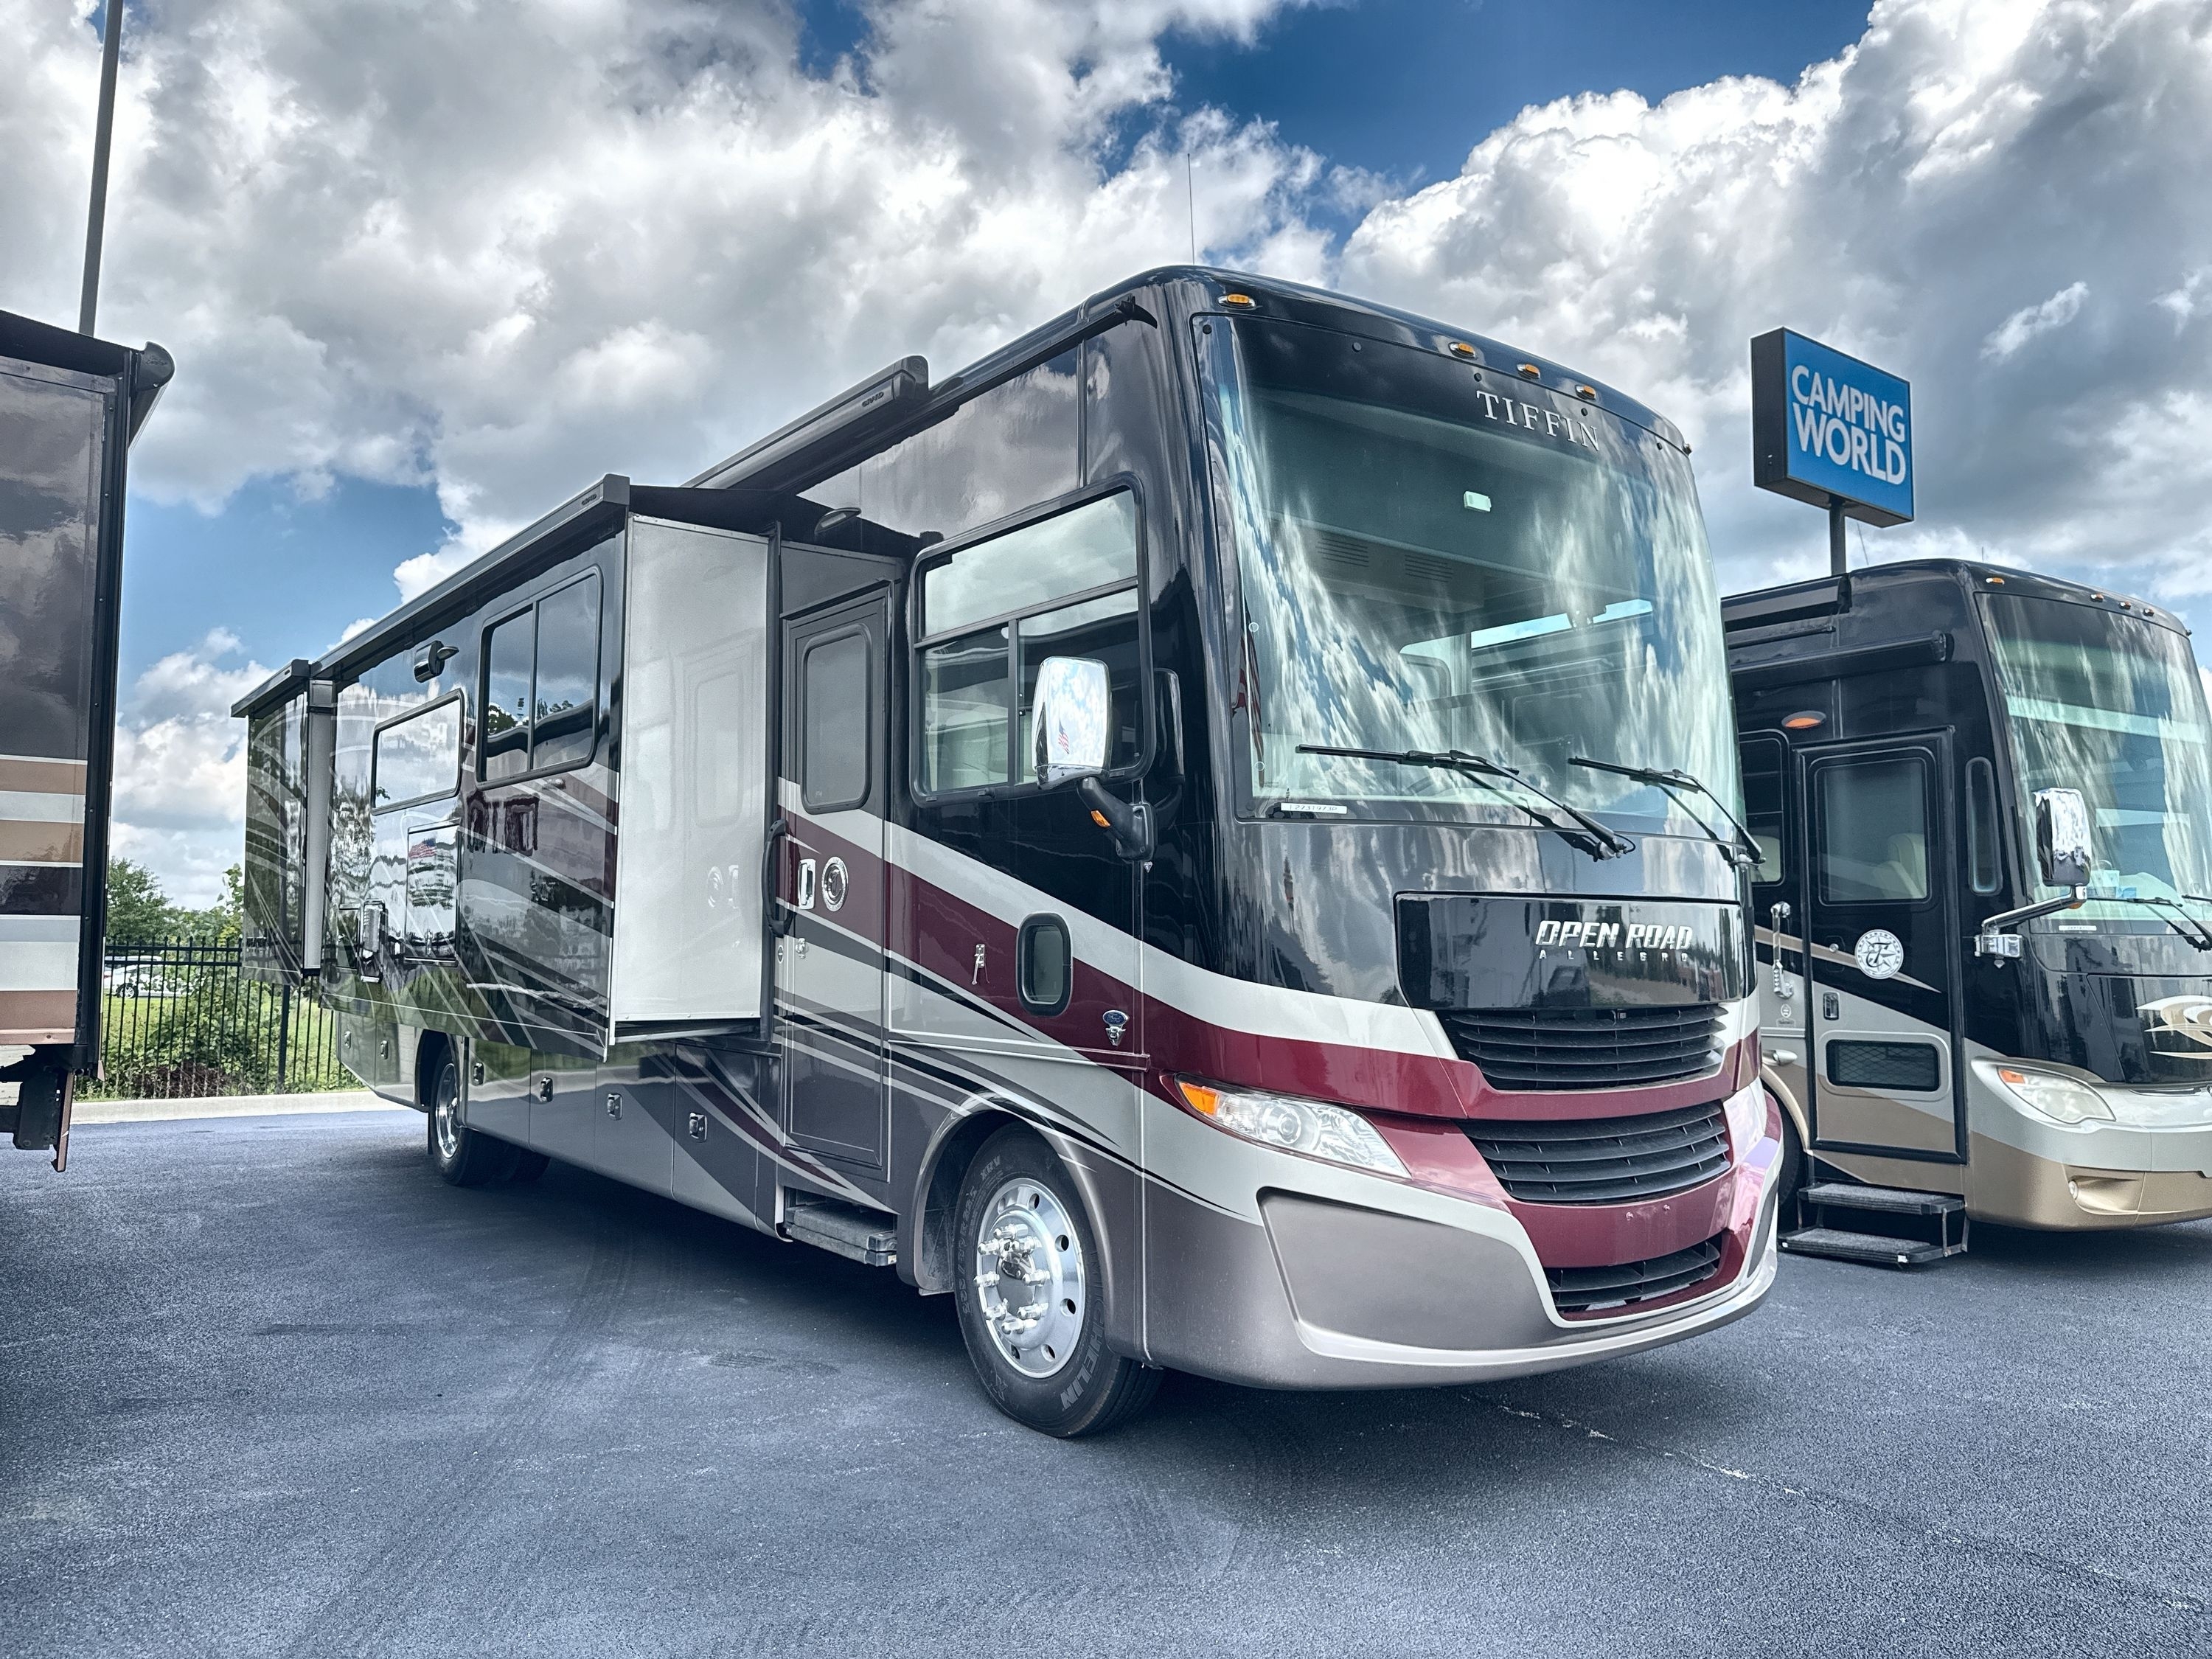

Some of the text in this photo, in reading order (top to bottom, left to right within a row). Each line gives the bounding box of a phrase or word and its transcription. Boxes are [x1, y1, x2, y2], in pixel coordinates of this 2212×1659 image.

[1476, 390, 1599, 451] TIFFIN
[1791, 365, 1905, 442] CAMPING
[1792, 402, 1906, 485] WORLD
[1535, 920, 1693, 950] OPEN ROAD
[1539, 950, 1688, 961] ALLEGRO
[1060, 1251, 1105, 1411] MICHELIN
